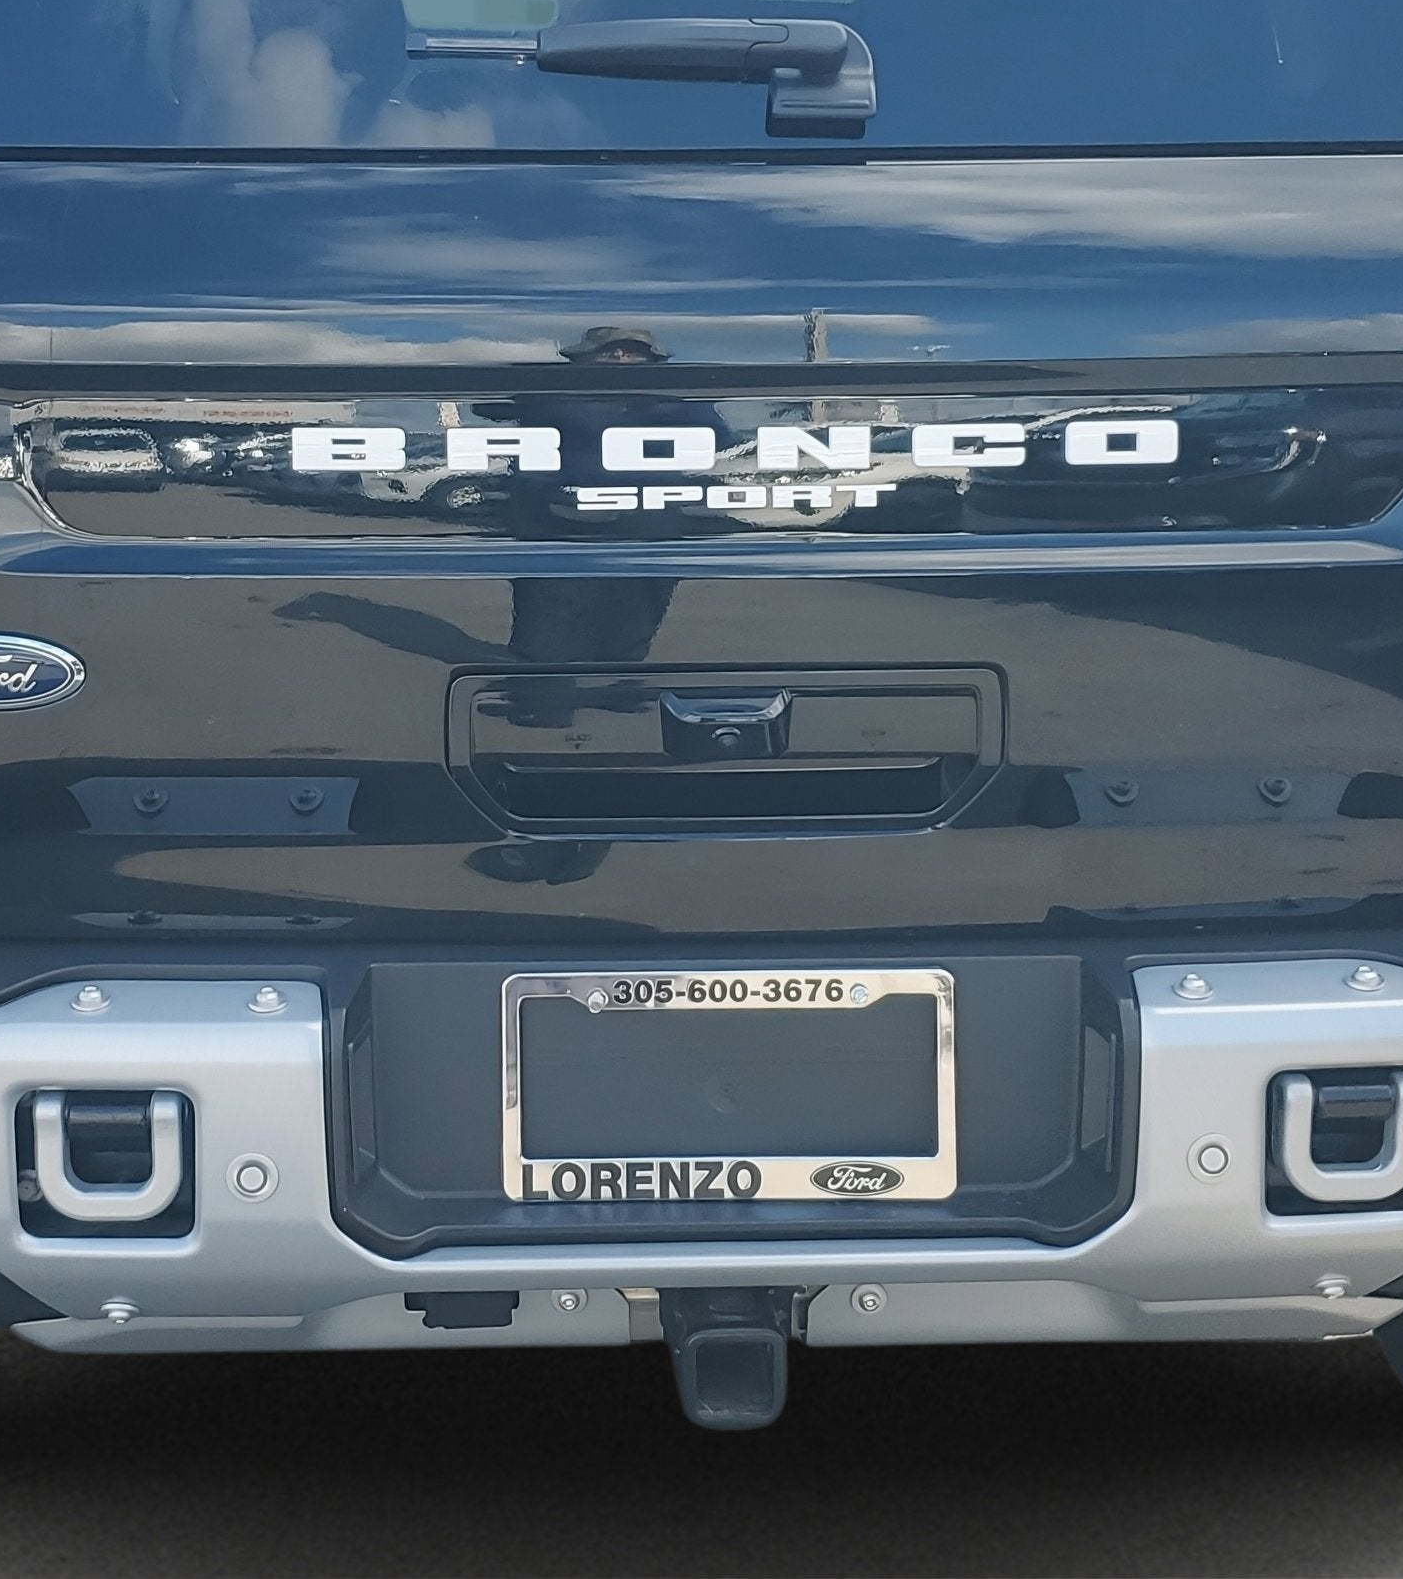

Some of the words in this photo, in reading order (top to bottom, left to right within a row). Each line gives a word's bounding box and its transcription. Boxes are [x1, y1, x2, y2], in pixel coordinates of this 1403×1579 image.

[290, 419, 1179, 472] BRONCO
[576, 483, 897, 511] SPORT
[612, 978, 845, 1004] 305-600-3676
[522, 1160, 762, 1200] LORENZO
[827, 1166, 886, 1191] Ford
